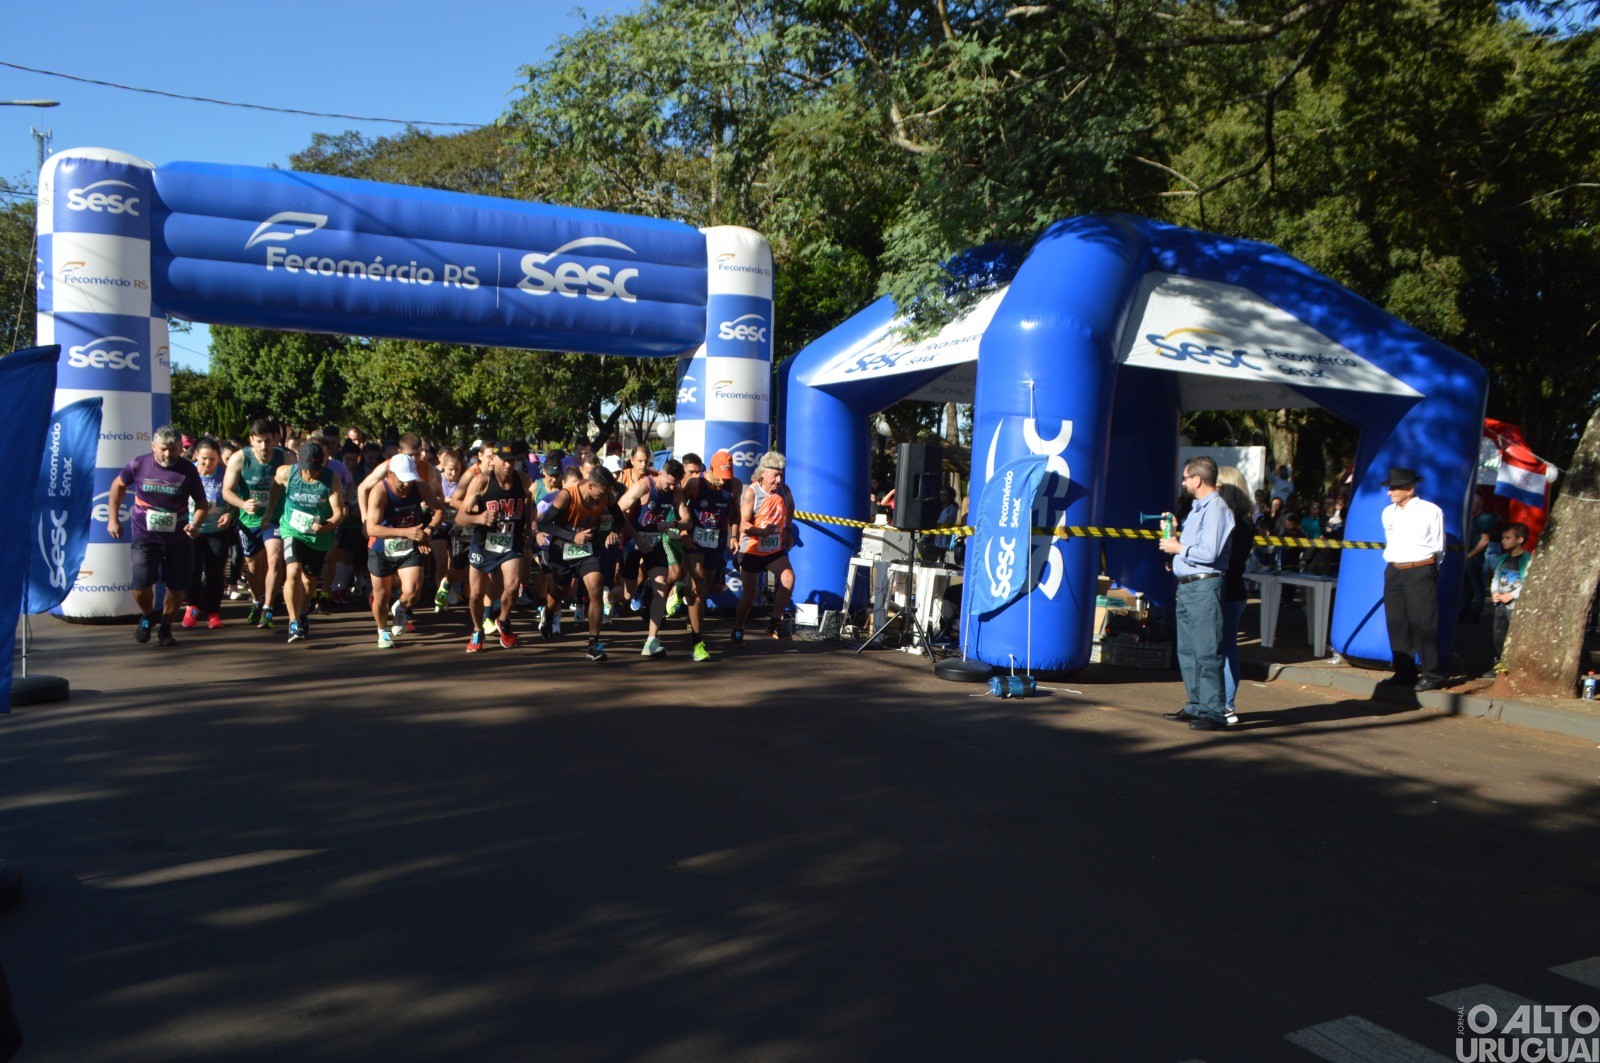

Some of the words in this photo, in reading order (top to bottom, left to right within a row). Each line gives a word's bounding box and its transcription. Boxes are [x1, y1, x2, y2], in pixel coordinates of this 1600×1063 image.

[266, 246, 435, 286] Fecomércio
[443, 264, 480, 290] RS
[63, 273, 131, 288] Fecomércio
[133, 279, 148, 290] RS
[136, 432, 150, 441] RS
[48, 422, 62, 498] Fecomércio
[60, 457, 73, 497] Senac
[998, 469, 1015, 528] Fecomércio
[150, 513, 173, 526] 558
[1010, 497, 1022, 529] Senac
[489, 535, 511, 546] 629
[696, 530, 715, 541] 514
[760, 536, 779, 547] 690
[72, 580, 133, 594] Fecomérci
